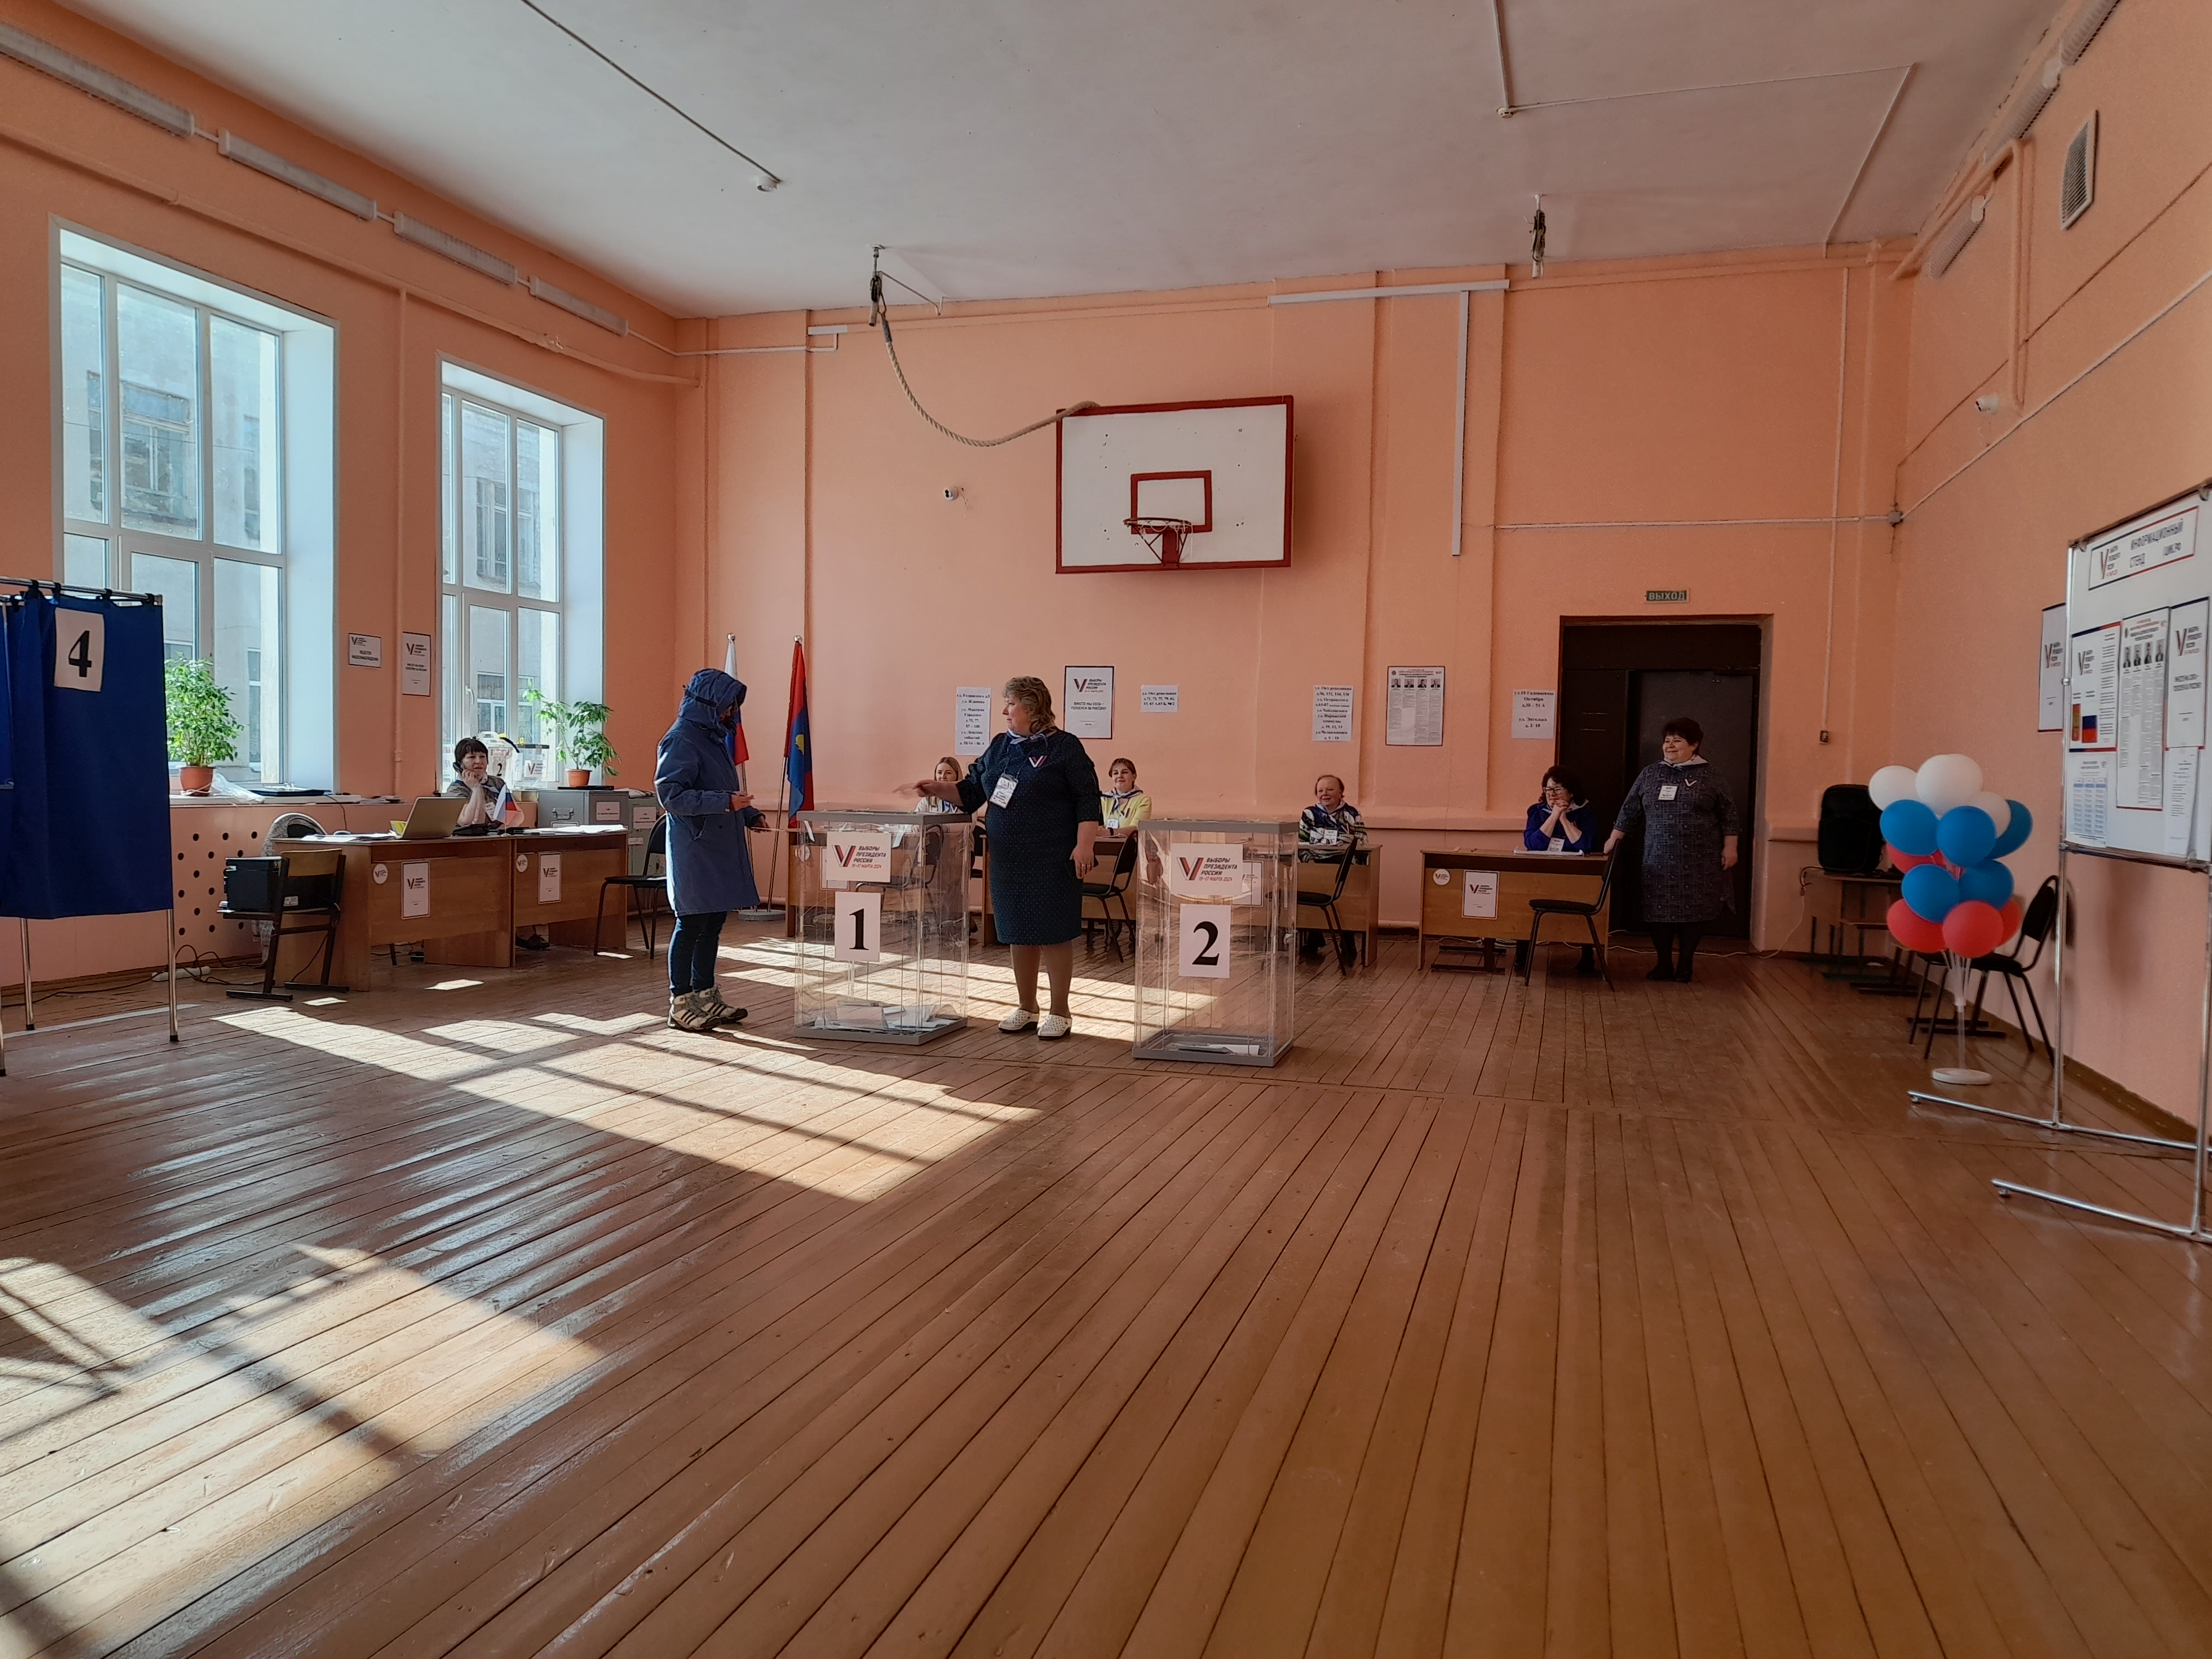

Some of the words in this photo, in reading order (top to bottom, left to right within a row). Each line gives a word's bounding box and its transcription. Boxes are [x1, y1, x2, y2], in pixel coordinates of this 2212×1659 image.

[1648, 592, 1685, 601] ВЫХОД
[69, 630, 92, 677] 4
[497, 763, 502, 776] 2
[849, 908, 869, 950] 1
[1192, 921, 1219, 966] 2
